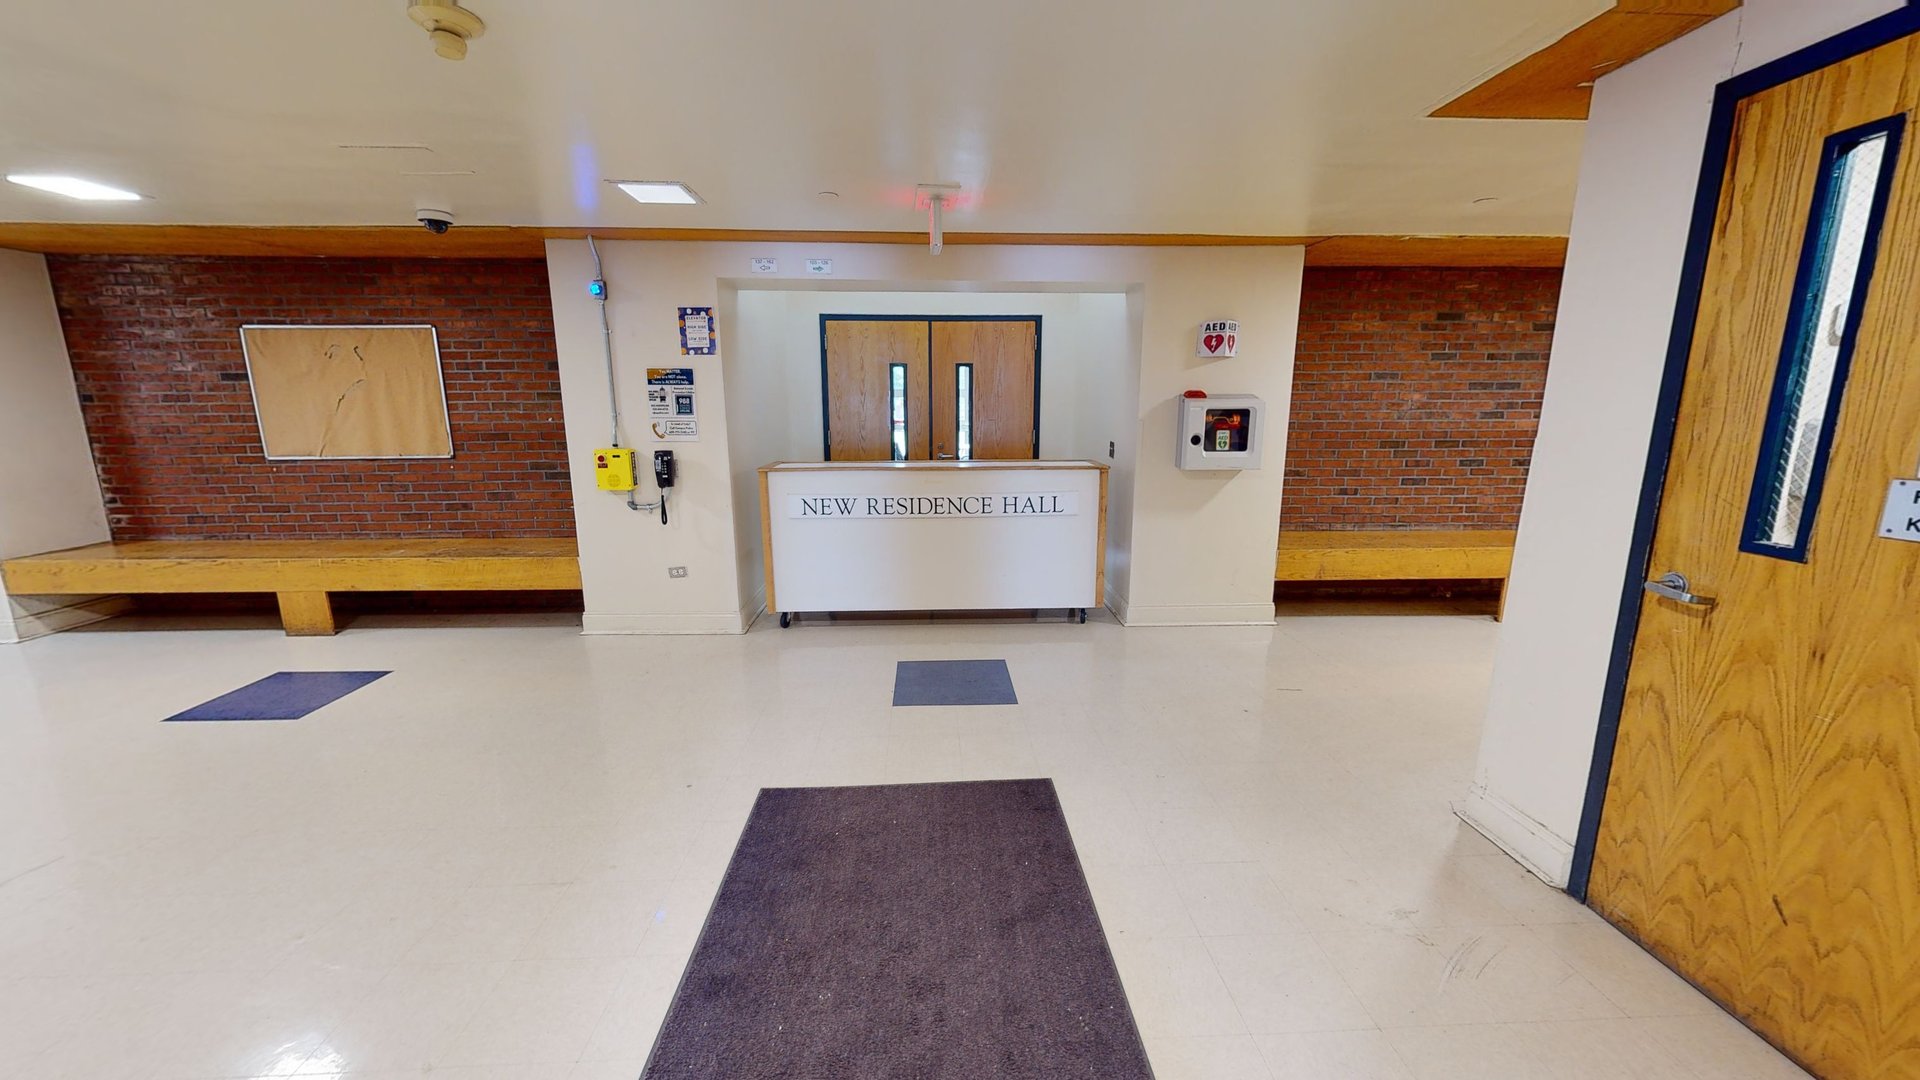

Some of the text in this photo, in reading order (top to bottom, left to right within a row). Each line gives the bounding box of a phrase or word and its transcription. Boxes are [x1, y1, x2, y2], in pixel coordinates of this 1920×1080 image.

[1204, 322, 1226, 332] AED
[802, 496, 1064, 516] NEW RESIDENCE HALL
